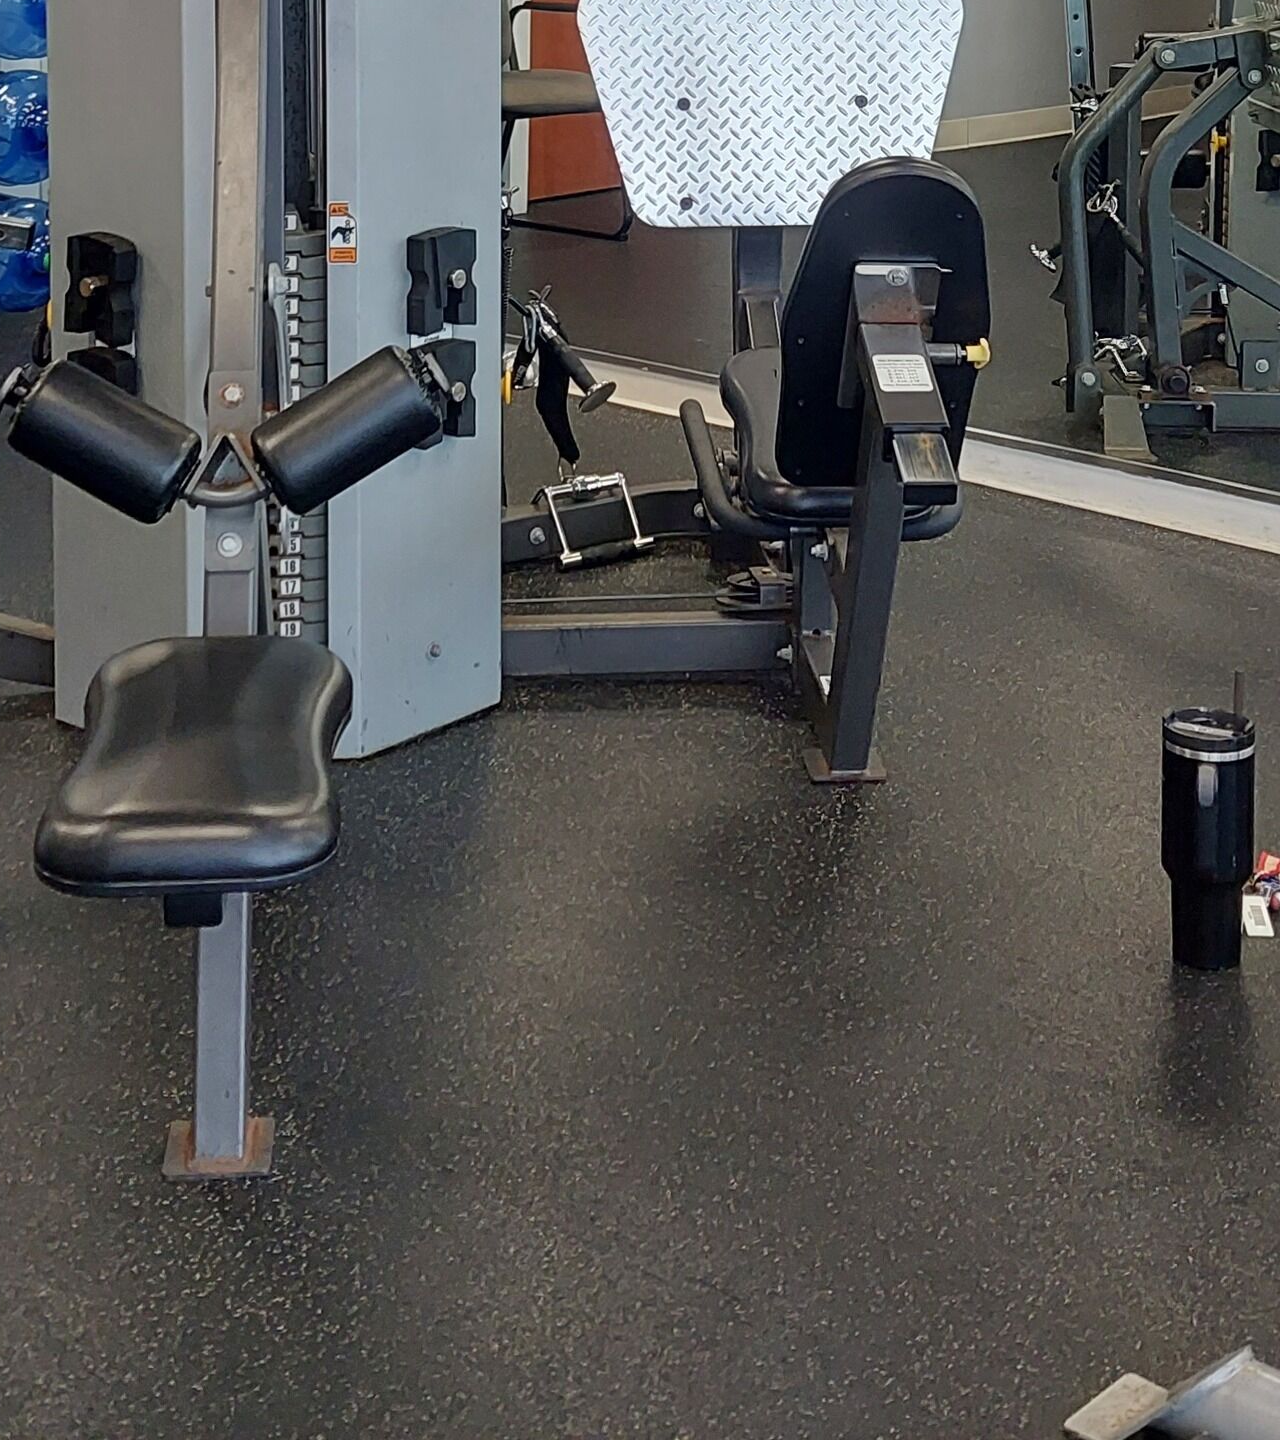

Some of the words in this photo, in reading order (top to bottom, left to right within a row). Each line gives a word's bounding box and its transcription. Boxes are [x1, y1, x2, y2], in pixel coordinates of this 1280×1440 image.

[284, 560, 296, 573] 16
[284, 581, 296, 593] 17
[284, 603, 295, 616] 18
[284, 623, 296, 636] 19
